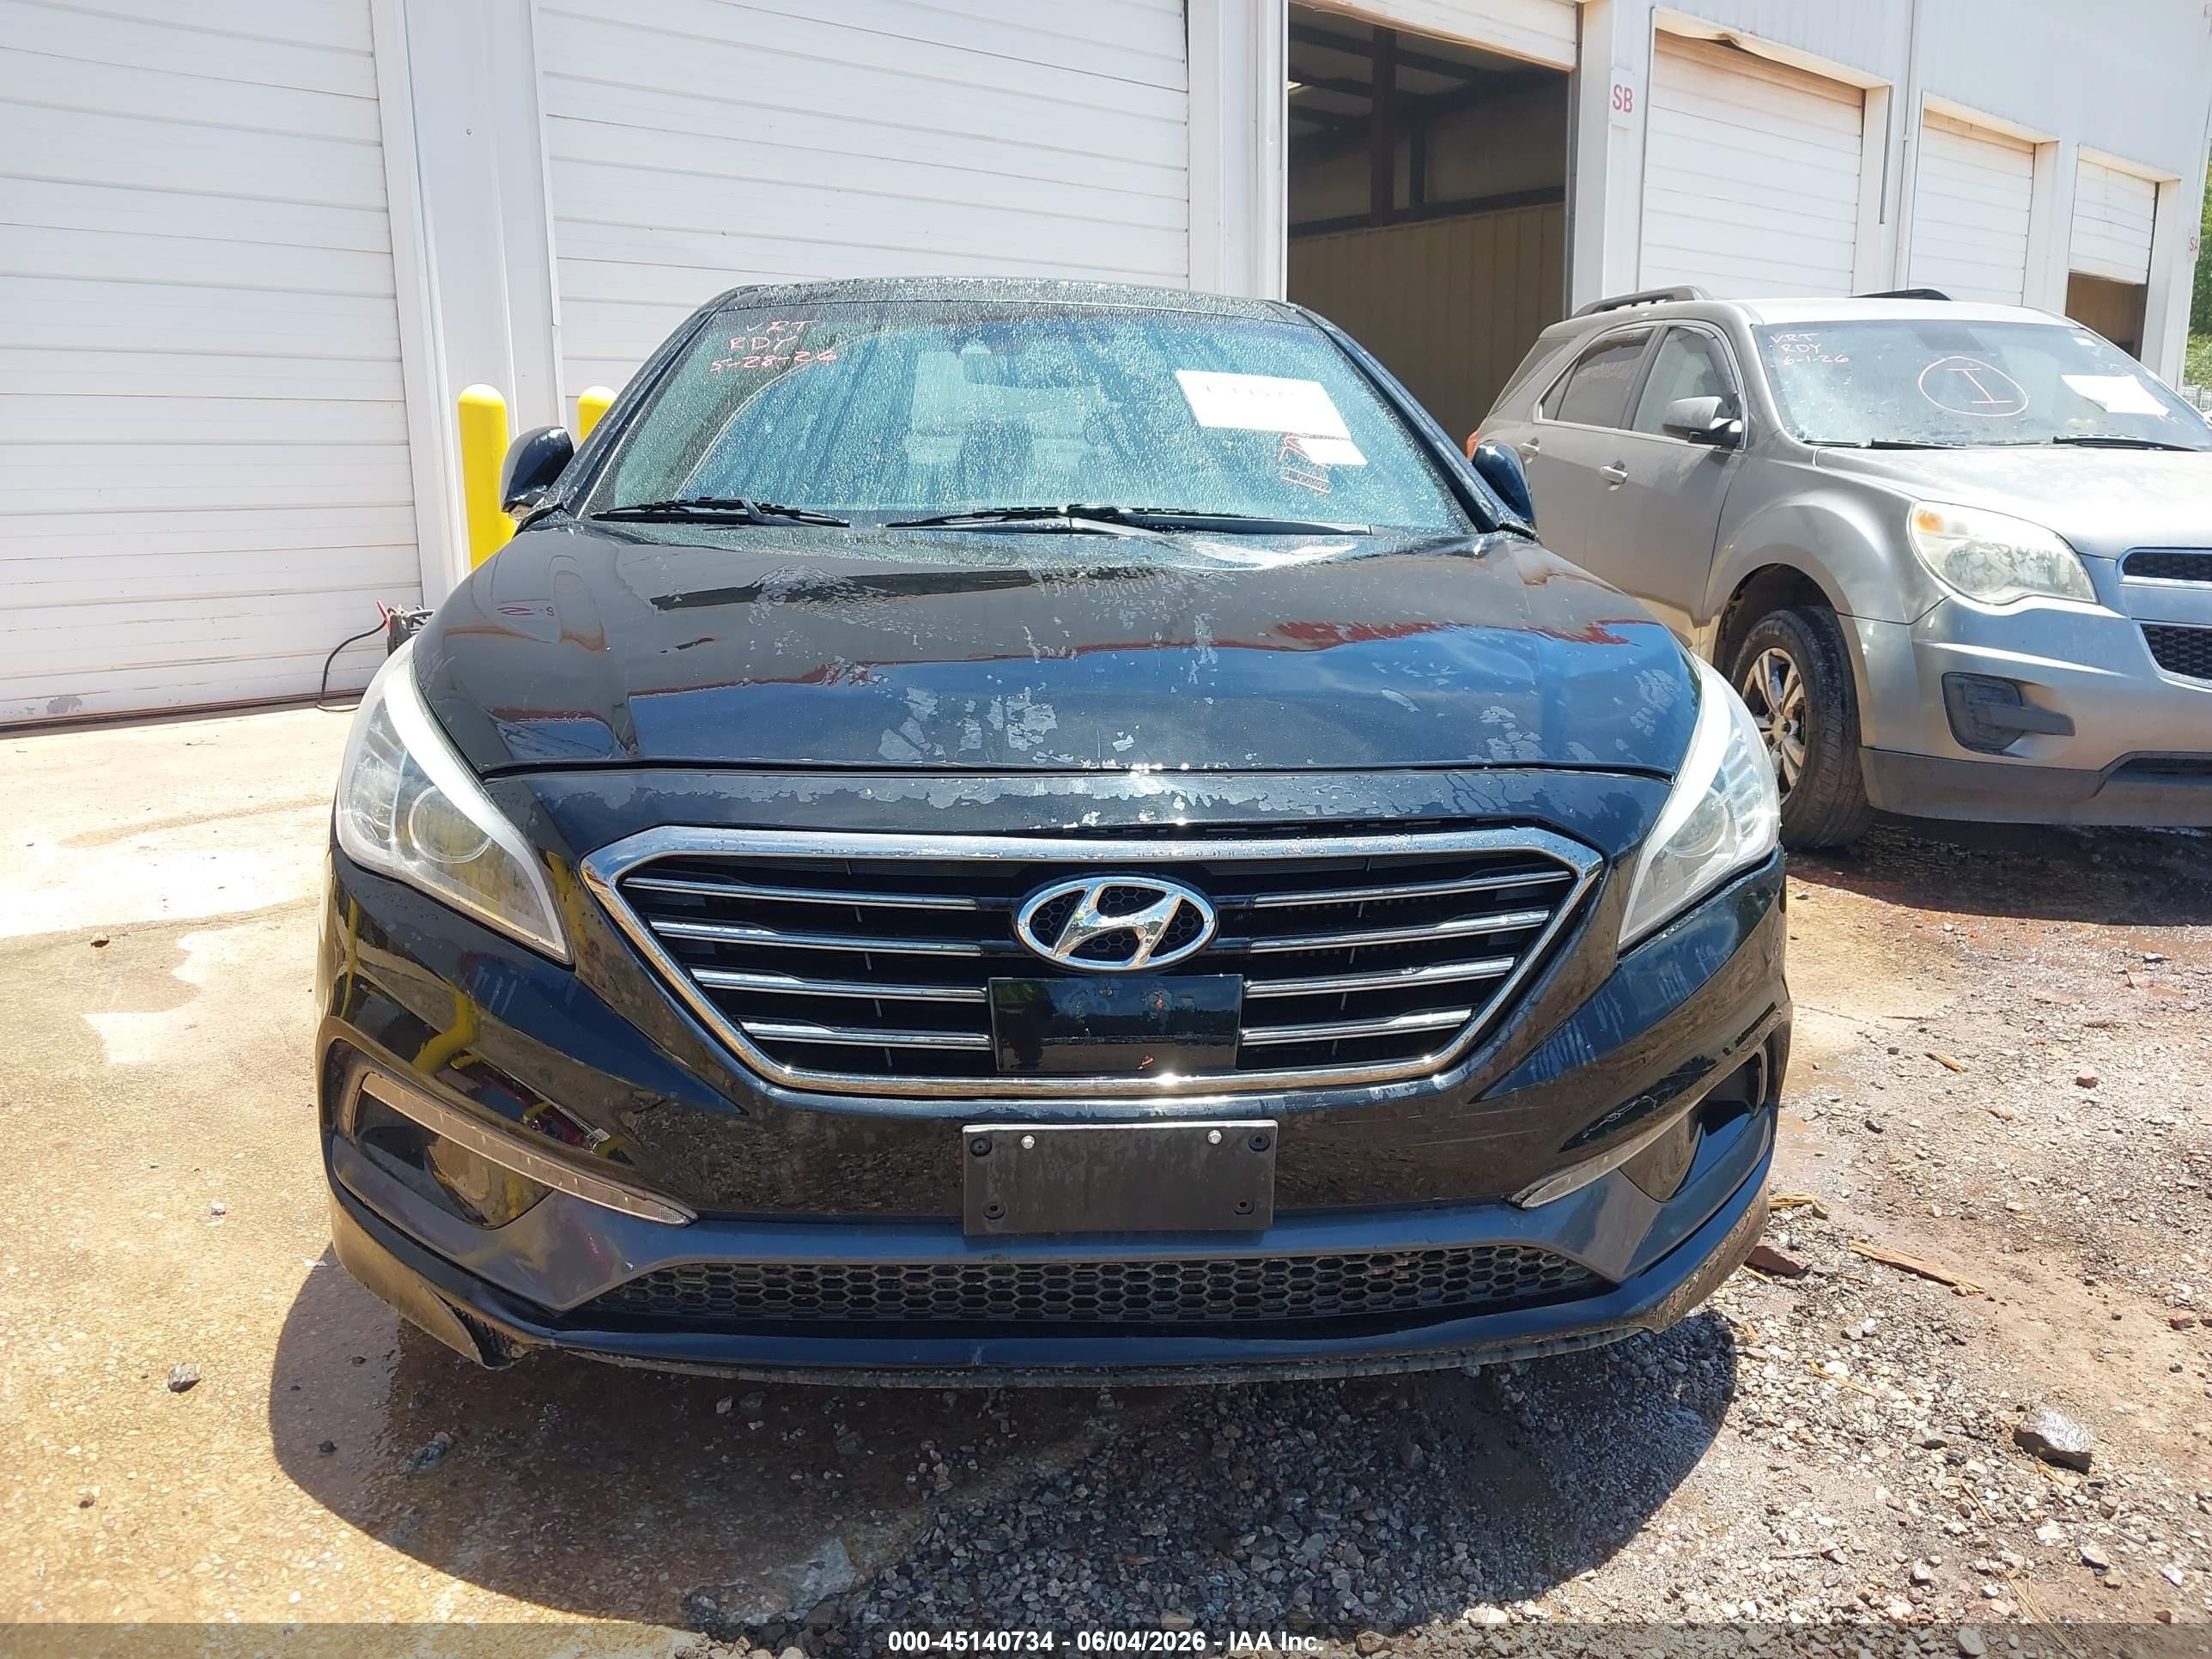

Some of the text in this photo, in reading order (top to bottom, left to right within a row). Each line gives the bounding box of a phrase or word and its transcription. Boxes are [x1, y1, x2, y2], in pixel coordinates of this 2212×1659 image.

[1613, 83, 1633, 113] SB
[730, 335, 797, 351] RDY
[1770, 332, 1820, 343] VRT
[1781, 343, 1821, 354] RDY
[1784, 354, 1850, 365] 6-1-26
